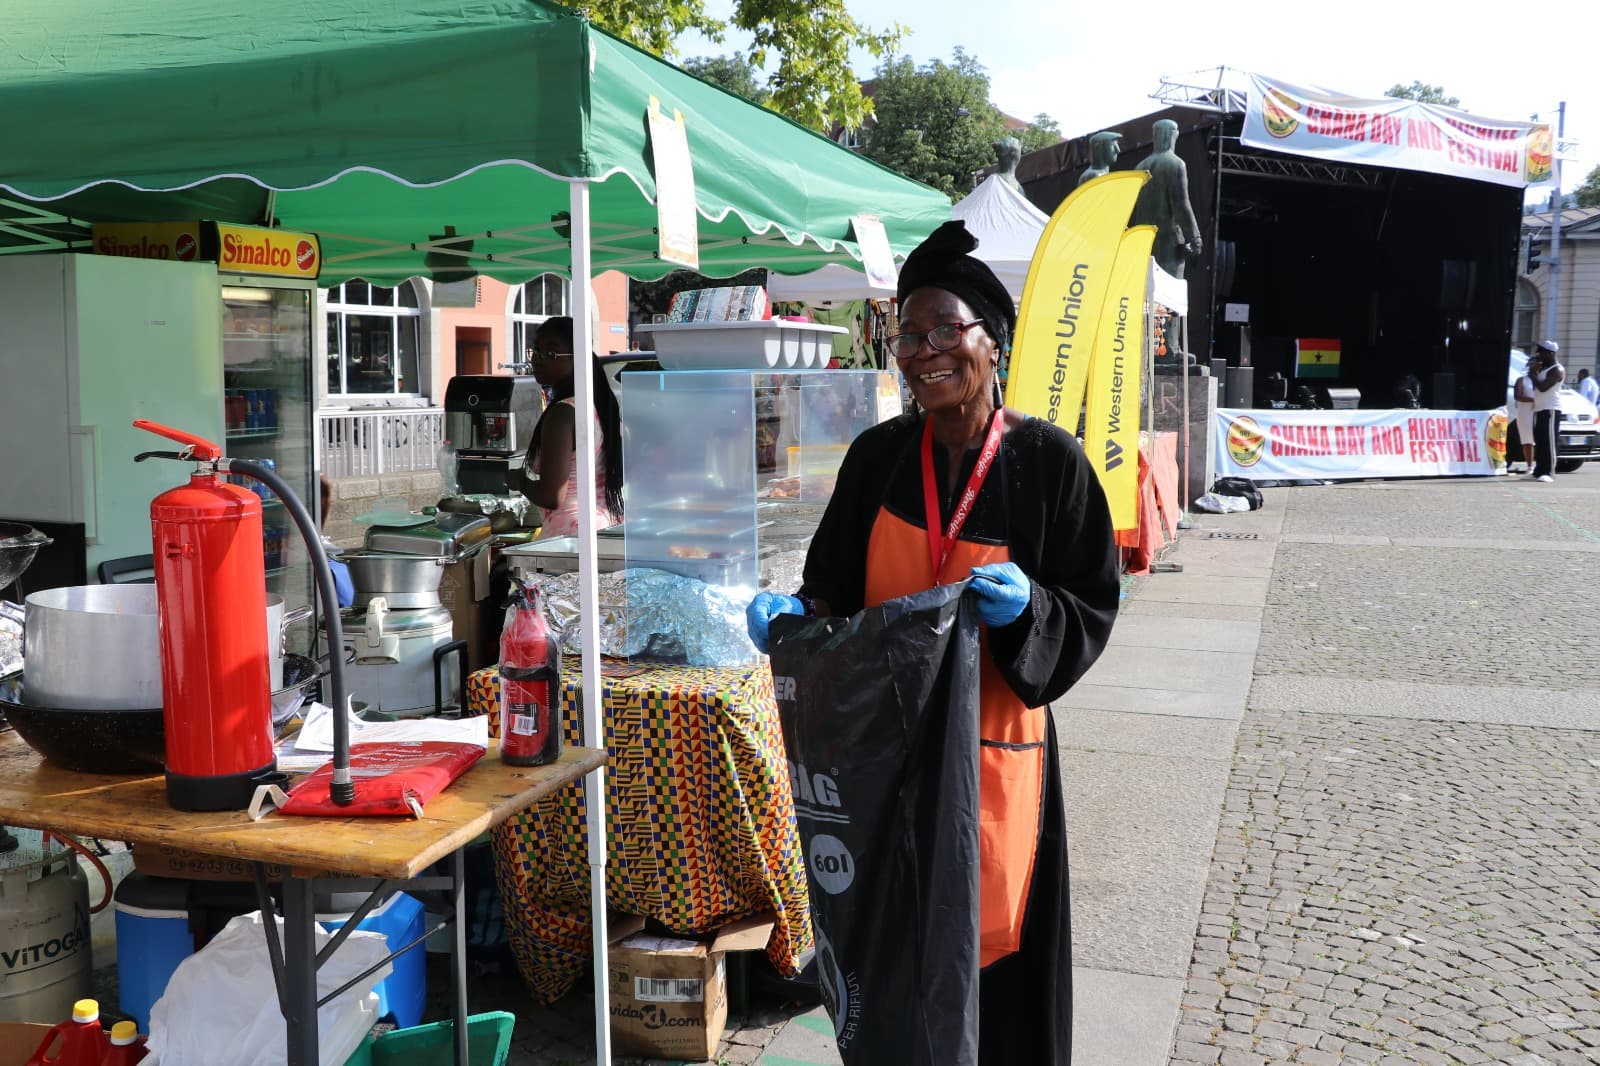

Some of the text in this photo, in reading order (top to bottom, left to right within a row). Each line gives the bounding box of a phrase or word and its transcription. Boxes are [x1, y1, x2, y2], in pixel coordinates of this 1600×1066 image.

[1369, 113, 1402, 146] DAY
[1406, 118, 1442, 152] AND
[1447, 138, 1519, 173] FESTIVAL
[223, 233, 291, 267] Sinalco
[1047, 263, 1089, 424] estern Union
[1107, 296, 1129, 434] Western Union
[1269, 418, 1479, 457] GHANA DAY AND HIGHLIFE
[1409, 440, 1482, 463] FESTIVAL
[838, 1023, 857, 1050] PER
